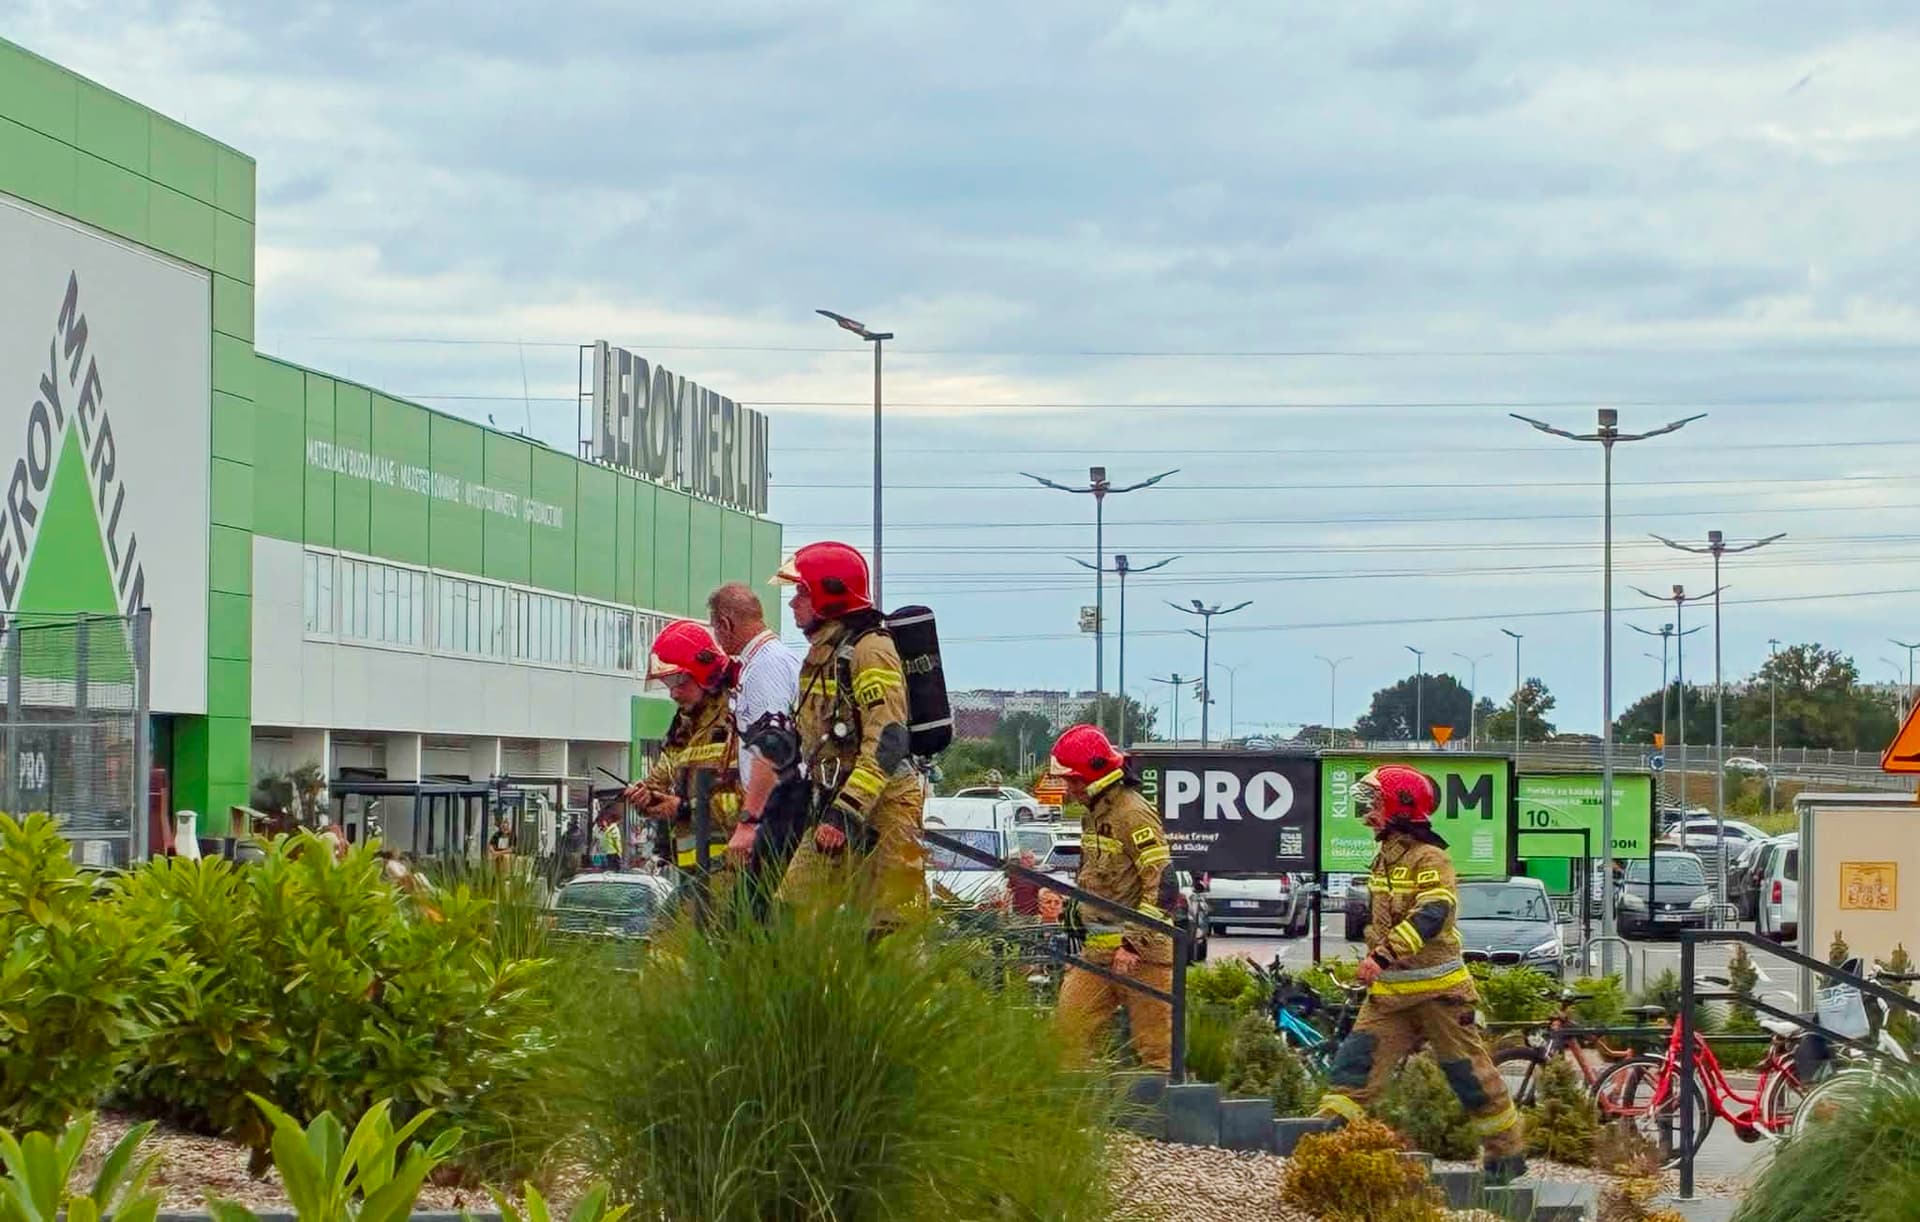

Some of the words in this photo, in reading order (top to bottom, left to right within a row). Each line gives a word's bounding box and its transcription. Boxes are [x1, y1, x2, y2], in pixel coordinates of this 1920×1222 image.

[592, 340, 684, 487] LEROY
[680, 381, 769, 515] MERLIN
[0, 336, 64, 632] EROY
[18, 752, 46, 789] PRO
[1143, 769, 1158, 810] LUB
[1332, 769, 1348, 818] KLUB
[1165, 770, 1294, 821] PRO
[1526, 810, 1550, 827] 10
